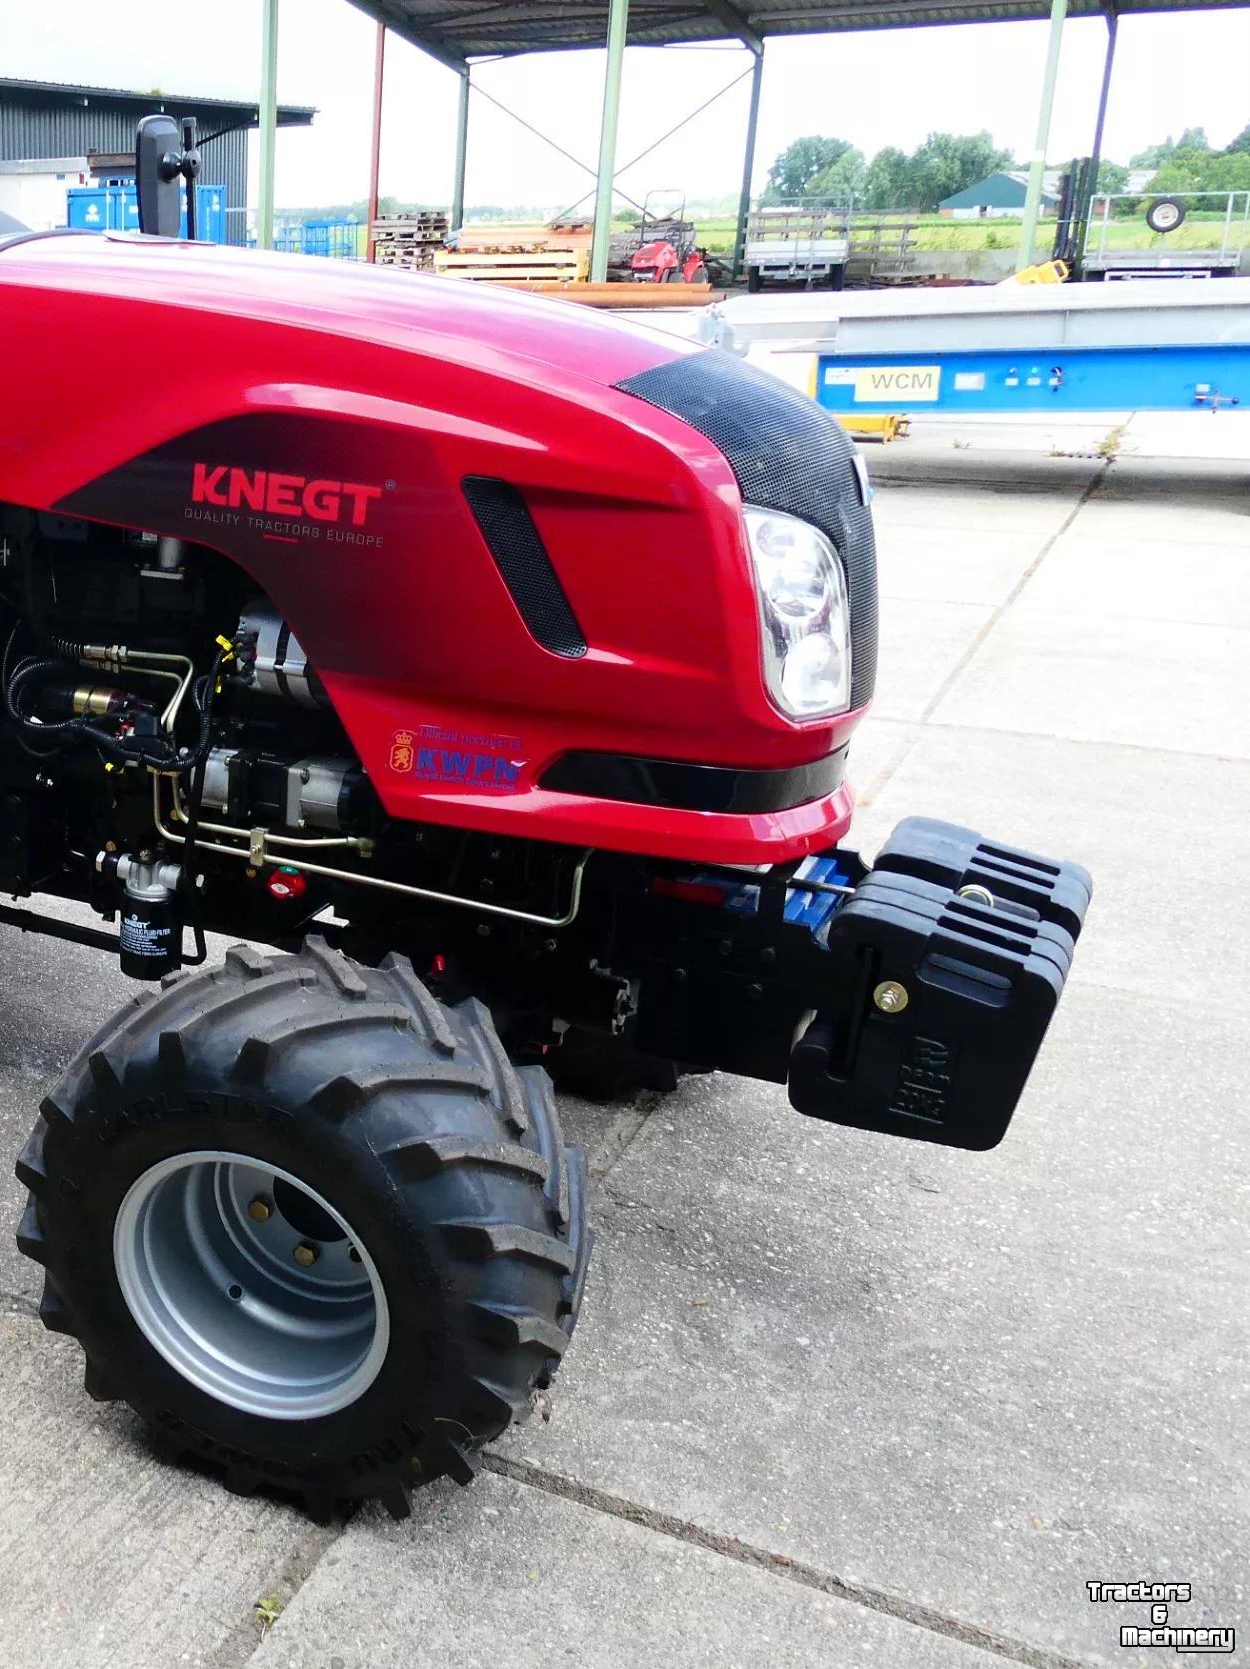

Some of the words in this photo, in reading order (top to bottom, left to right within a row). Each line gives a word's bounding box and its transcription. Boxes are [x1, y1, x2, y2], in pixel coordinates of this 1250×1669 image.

[871, 372, 933, 390] WCM
[191, 462, 382, 527] KNEGT
[184, 507, 240, 526] QUALITY
[247, 516, 320, 539] TRACTORS
[326, 529, 384, 548] EUROPE
[417, 747, 518, 782] KWPN
